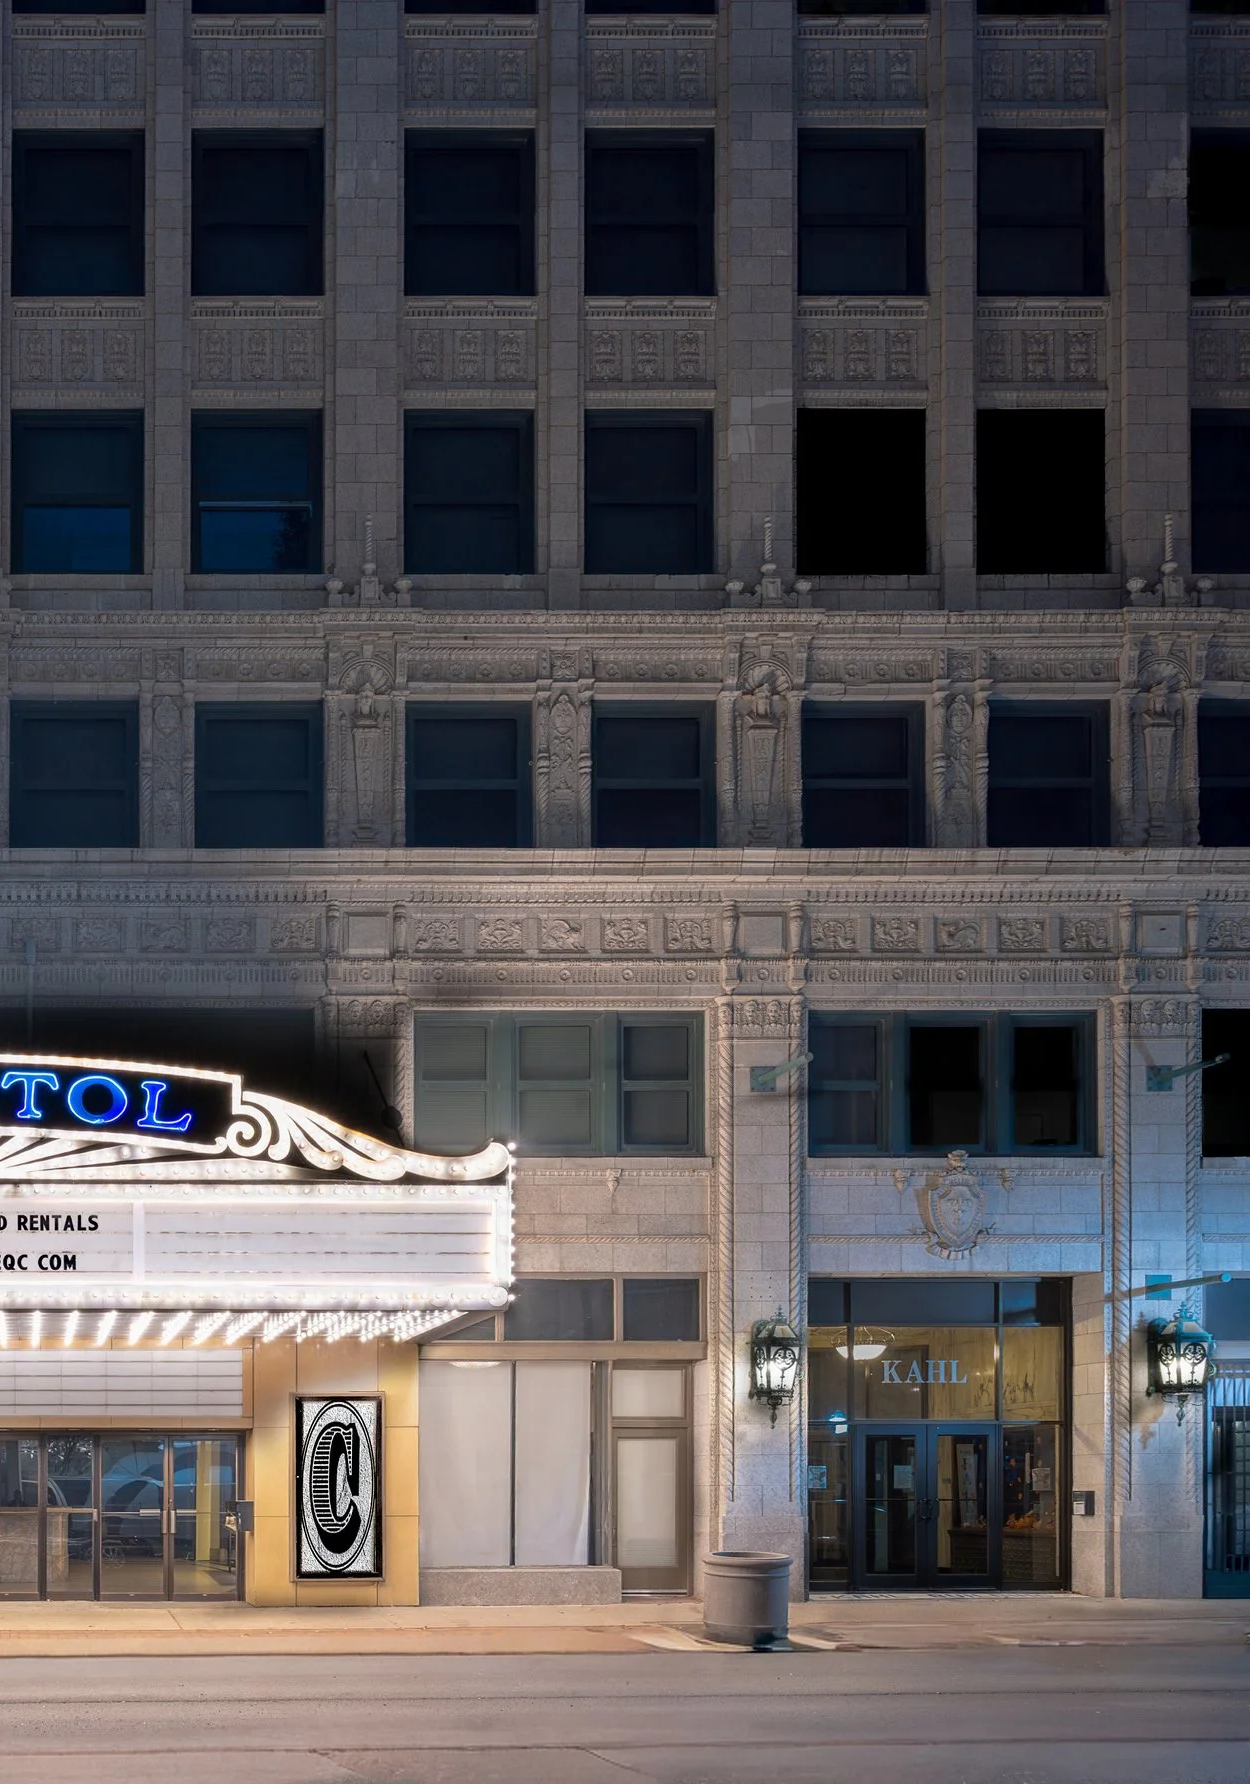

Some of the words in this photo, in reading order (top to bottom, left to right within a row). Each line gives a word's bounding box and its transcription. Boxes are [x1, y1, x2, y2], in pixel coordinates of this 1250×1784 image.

[17, 1214, 99, 1232] RENTALS
[37, 1254, 77, 1271] COM
[881, 1359, 968, 1384] KAHL
[308, 1420, 362, 1555] C
